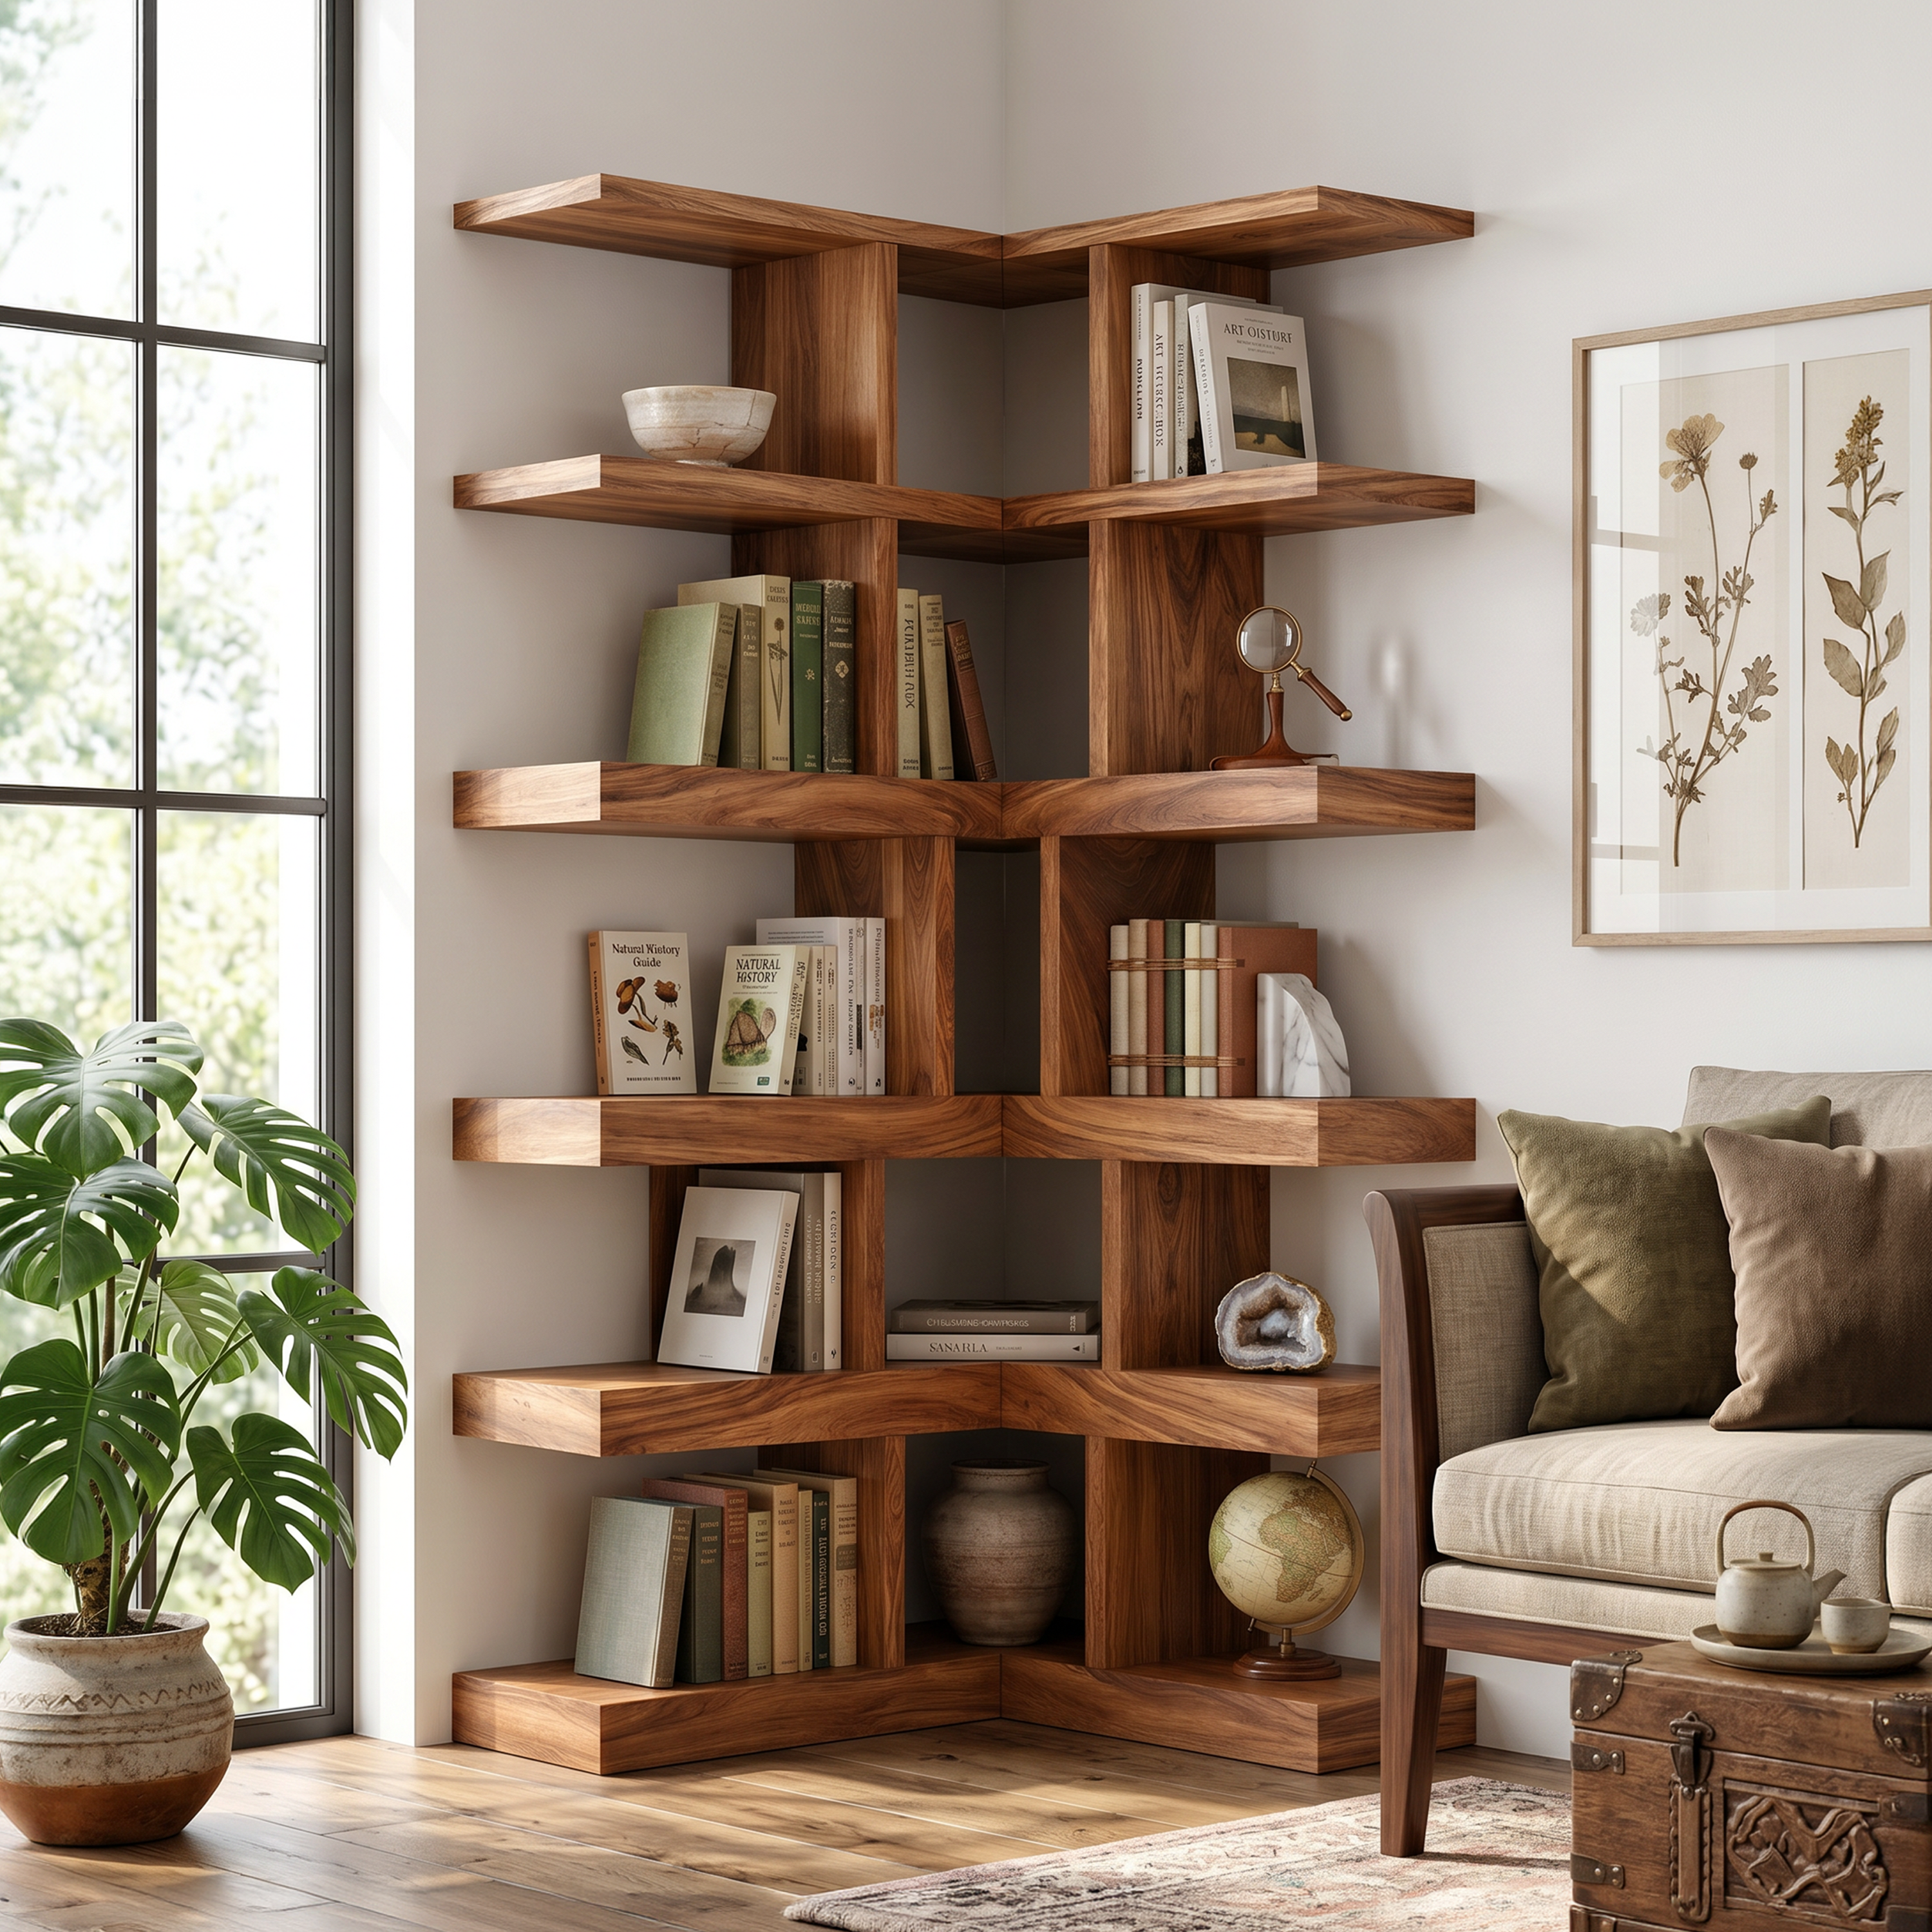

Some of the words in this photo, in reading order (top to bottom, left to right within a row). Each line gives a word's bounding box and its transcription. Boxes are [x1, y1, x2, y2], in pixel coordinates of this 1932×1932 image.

[1224, 323, 1244, 336] ART
[612, 943, 644, 954] Natural
[633, 956, 661, 967] Guide
[735, 959, 781, 970] NATURAL
[736, 971, 777, 983] HISTORY
[929, 1342, 989, 1353] SANARLA
